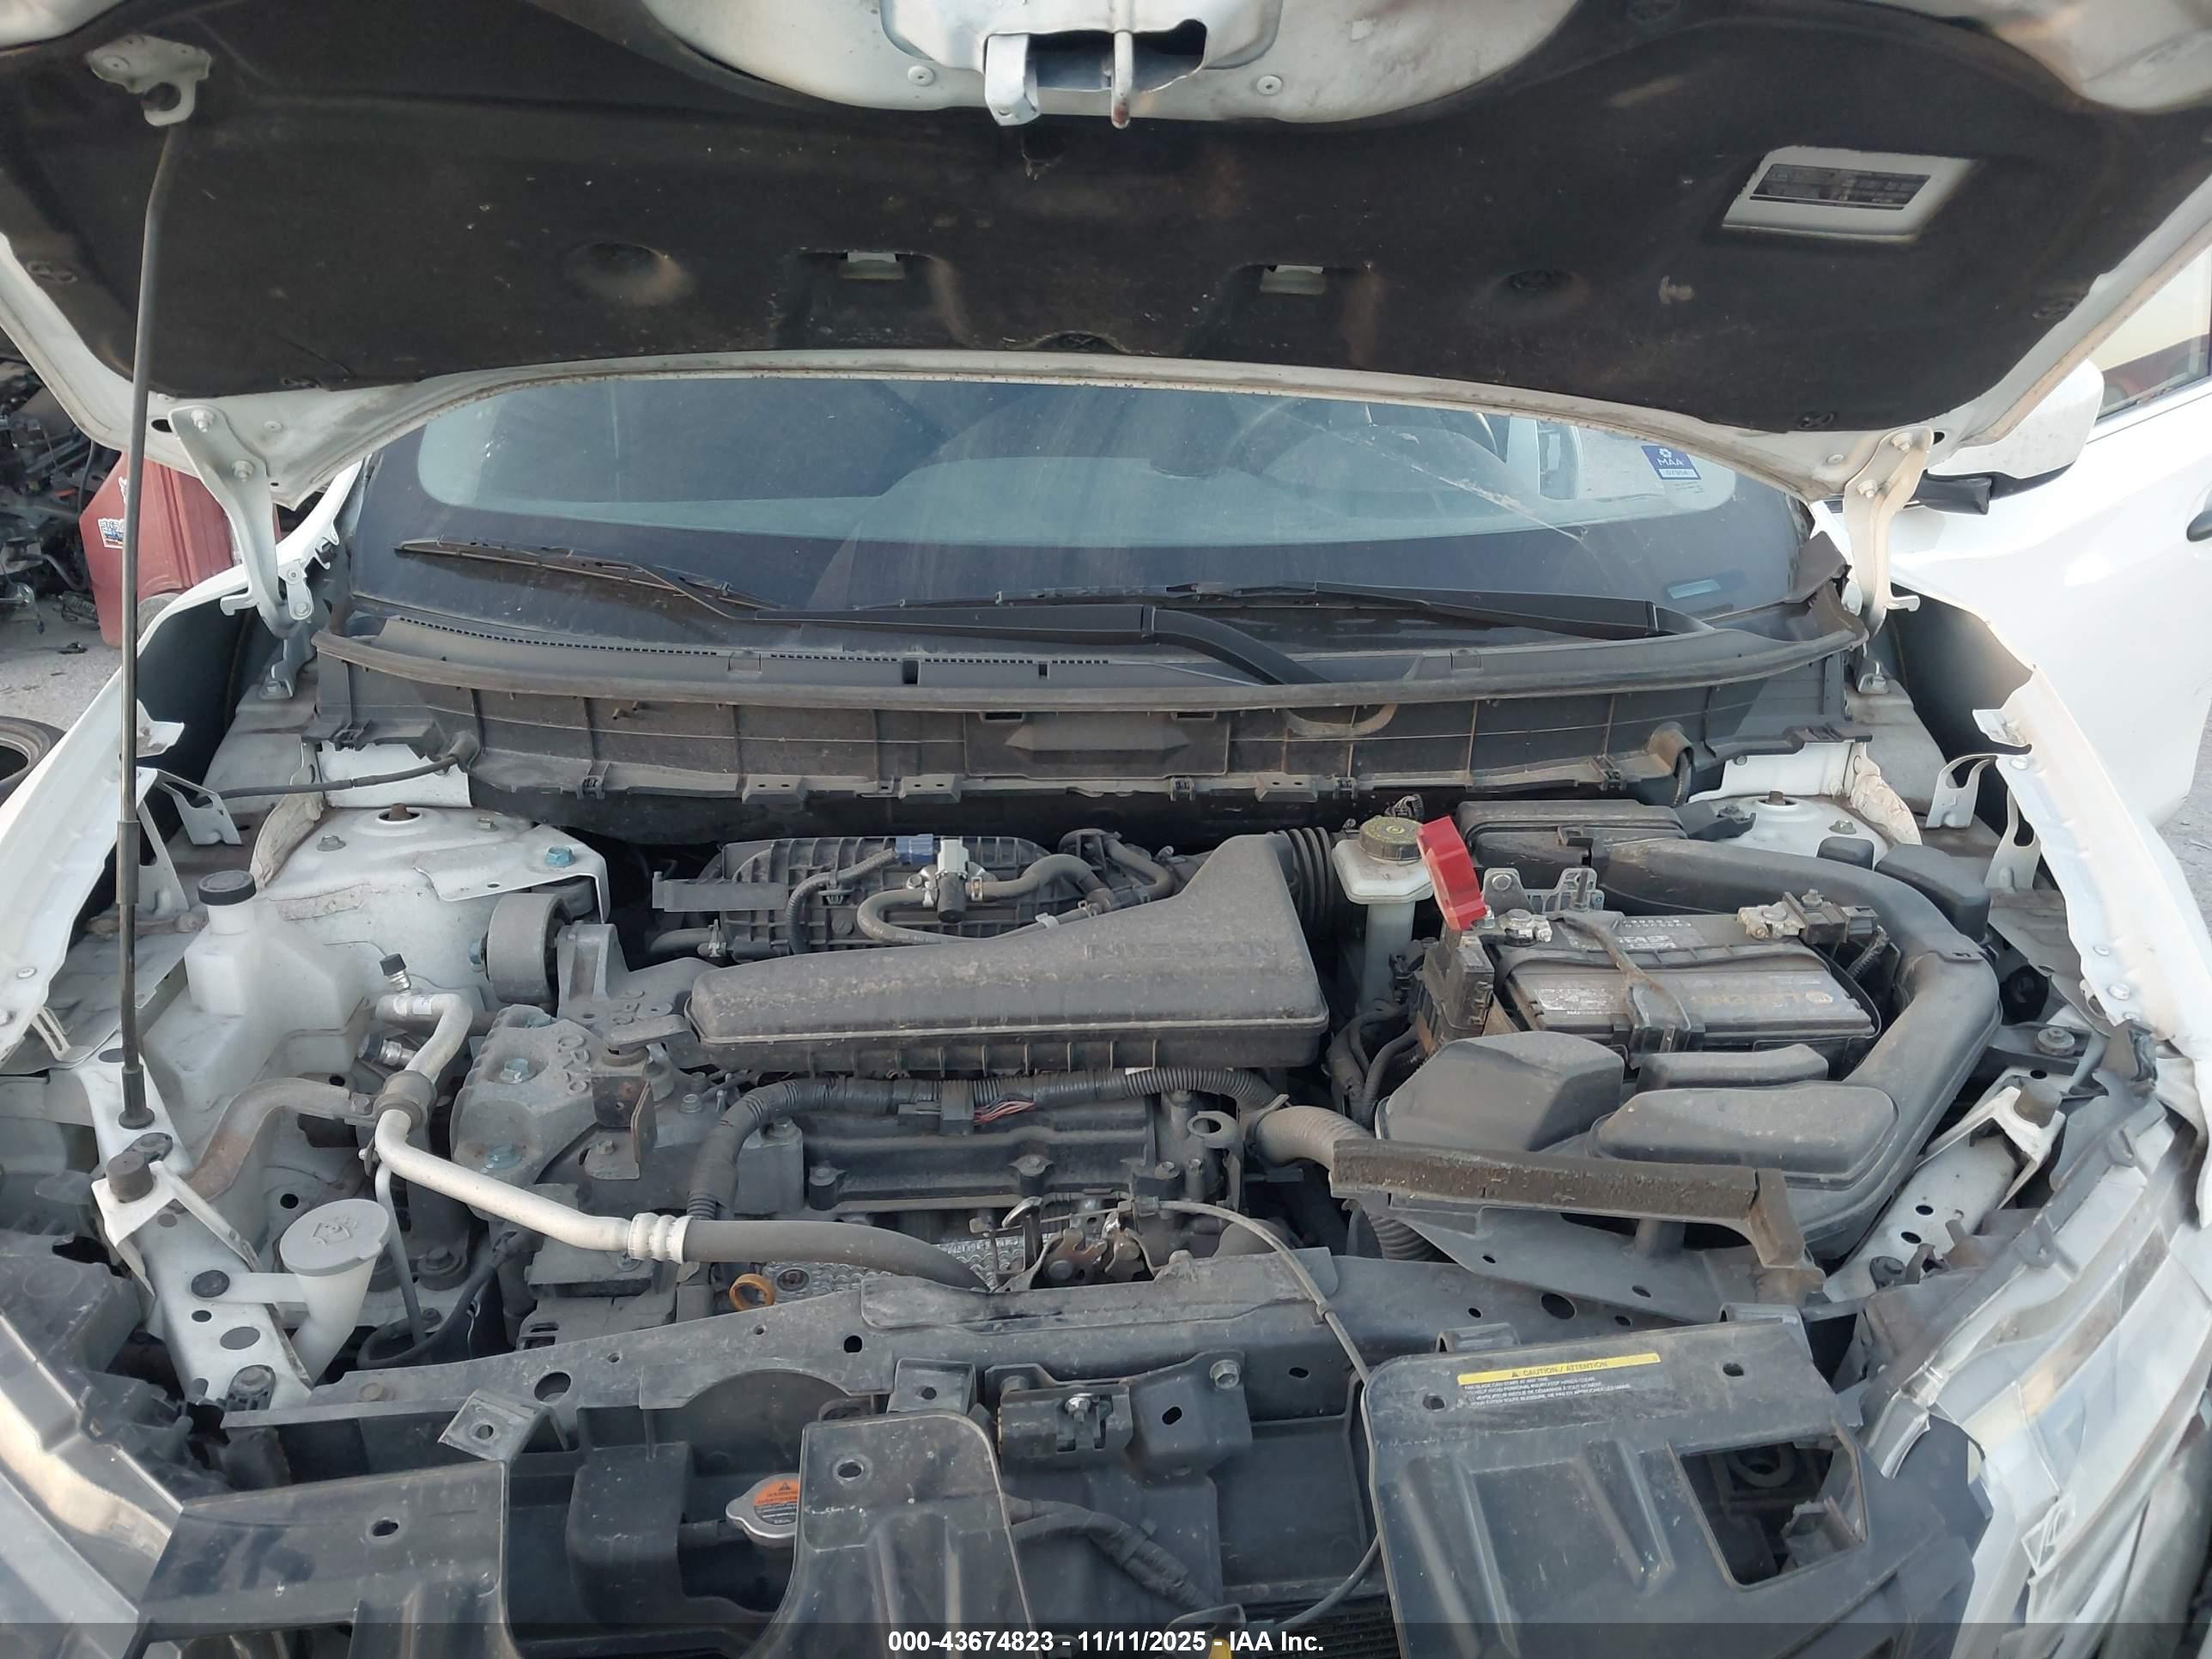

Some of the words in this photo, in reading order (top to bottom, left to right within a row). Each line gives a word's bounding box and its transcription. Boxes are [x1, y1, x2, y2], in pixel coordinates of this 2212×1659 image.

[1084, 941, 1279, 960] NISSAN
[1523, 1366, 1557, 1376] CAUTION
[1565, 1361, 1607, 1371] ATTENTION
